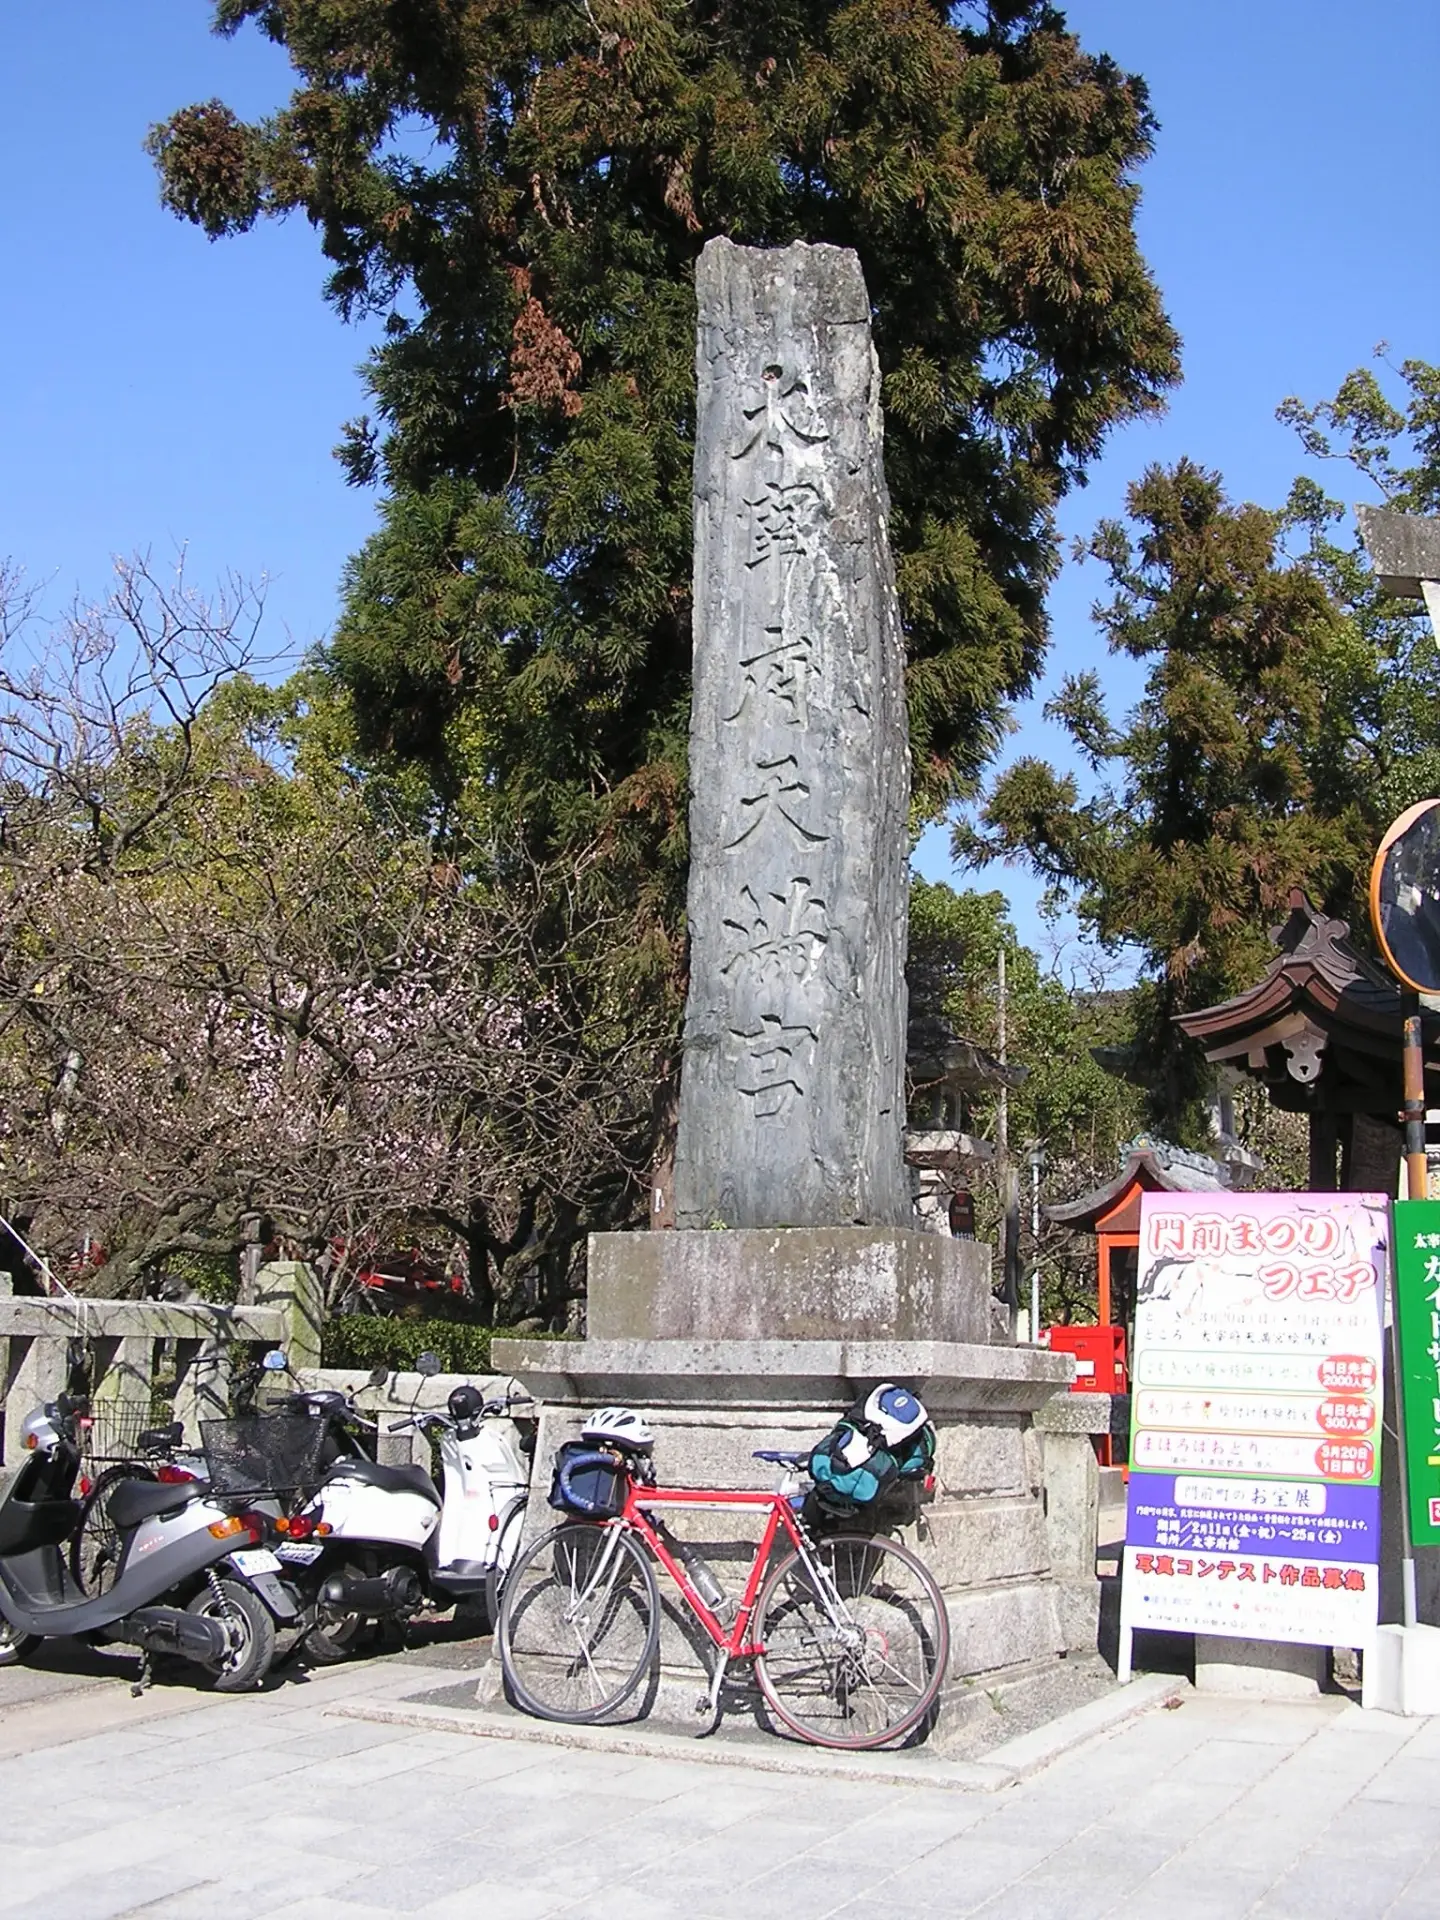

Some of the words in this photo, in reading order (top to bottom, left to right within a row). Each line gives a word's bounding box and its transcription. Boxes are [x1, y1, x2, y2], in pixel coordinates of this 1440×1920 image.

[1150, 1214, 1338, 1254] 門前まつり
[1135, 1553, 1366, 1592] 写真コンテスト作品募集
